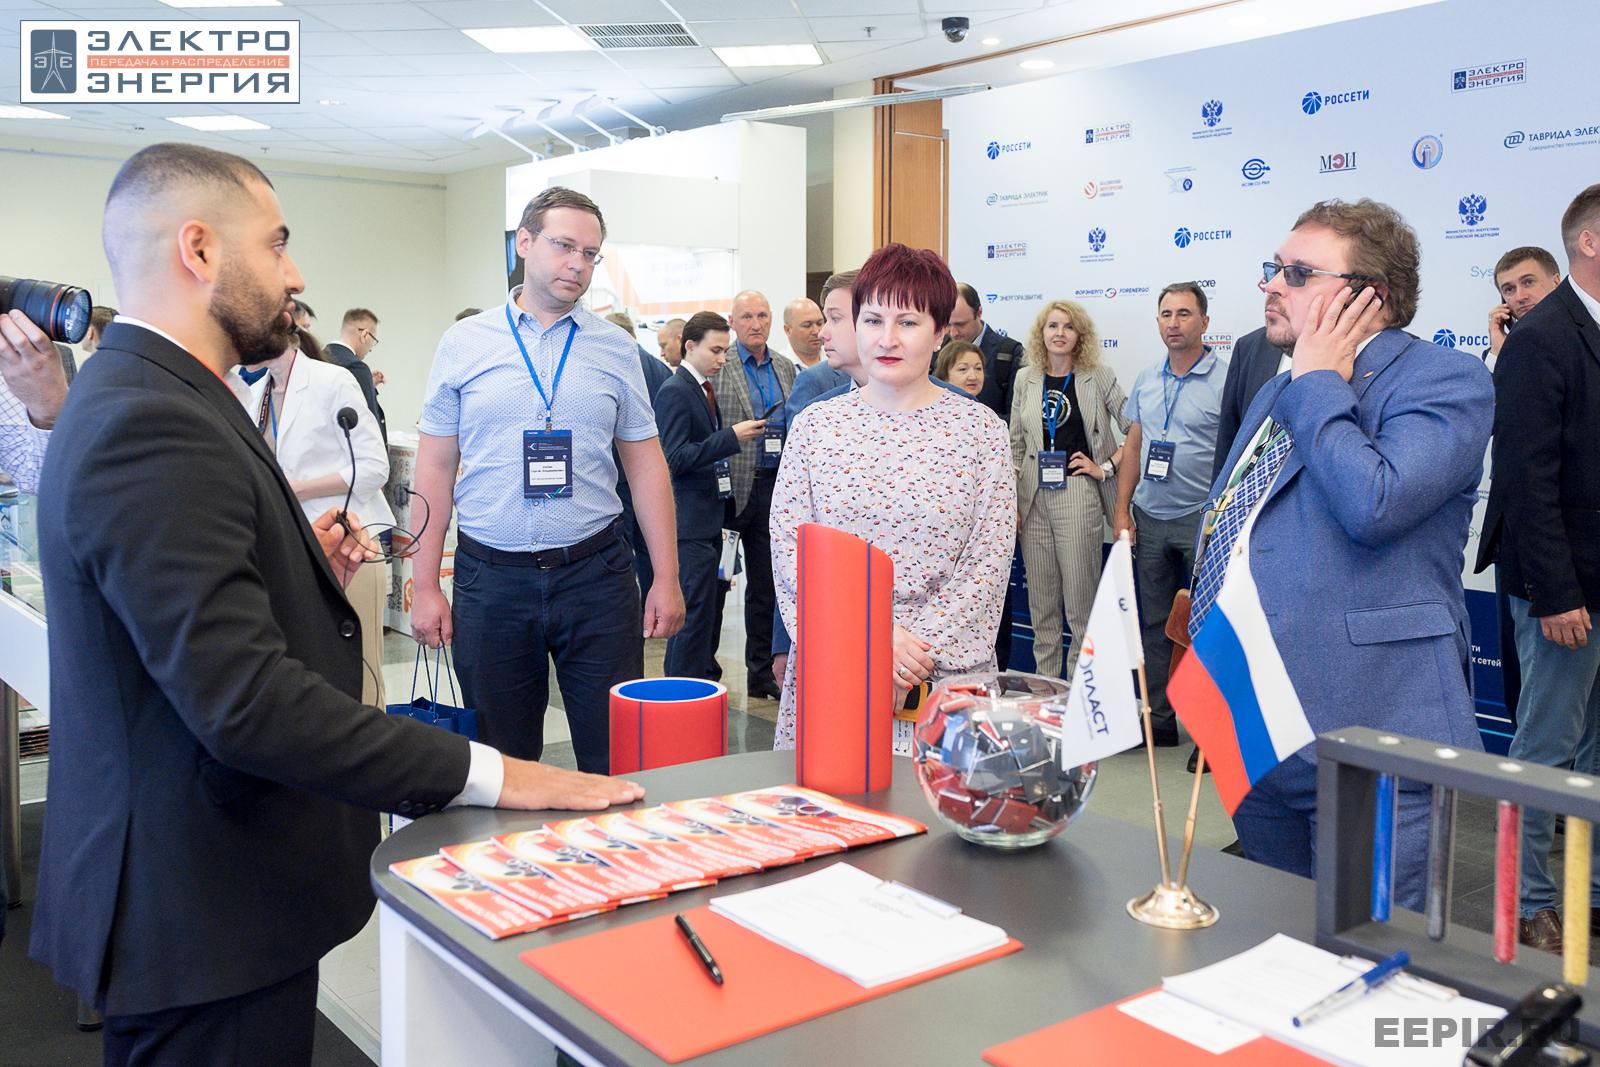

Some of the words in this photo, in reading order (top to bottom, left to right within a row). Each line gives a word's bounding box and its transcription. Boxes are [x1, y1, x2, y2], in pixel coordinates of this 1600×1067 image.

[1468, 61, 1524, 76] ЭЛЕКТРО
[1468, 74, 1524, 89] ЭНЕРГИЯ
[1324, 89, 1370, 106] РОССЕТИ
[1528, 129, 1572, 142] ТАВРИДА
[1001, 141, 1032, 153] РОССЕТИ
[1319, 151, 1358, 171] МЭИ
[1193, 229, 1232, 241] РОССЕТИ
[1459, 335, 1489, 346] РОСС
[1477, 656, 1502, 668] сетей
